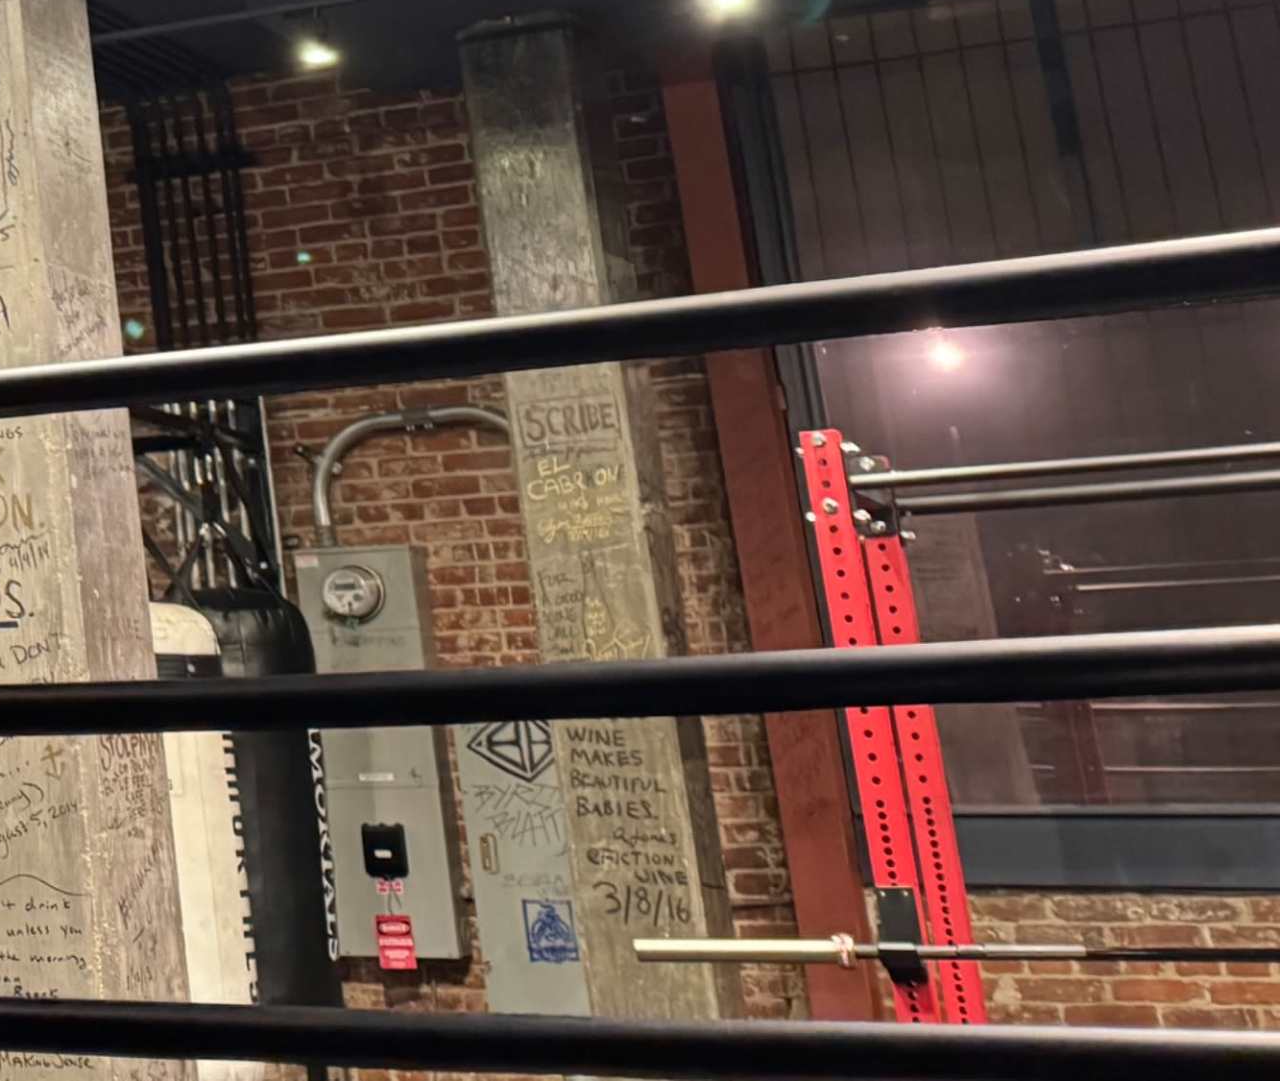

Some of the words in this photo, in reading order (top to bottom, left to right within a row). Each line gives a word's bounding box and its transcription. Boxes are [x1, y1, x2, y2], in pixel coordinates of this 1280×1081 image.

[525, 402, 615, 442] SCRIBE
[537, 457, 570, 477] EL
[566, 726, 626, 746] WINE
[570, 748, 643, 767] MAKES
[570, 770, 668, 794] BEAUTIFUL
[47, 800, 78, 820] 2014
[24, 896, 73, 913] drink
[592, 881, 690, 927] 3/8/16
